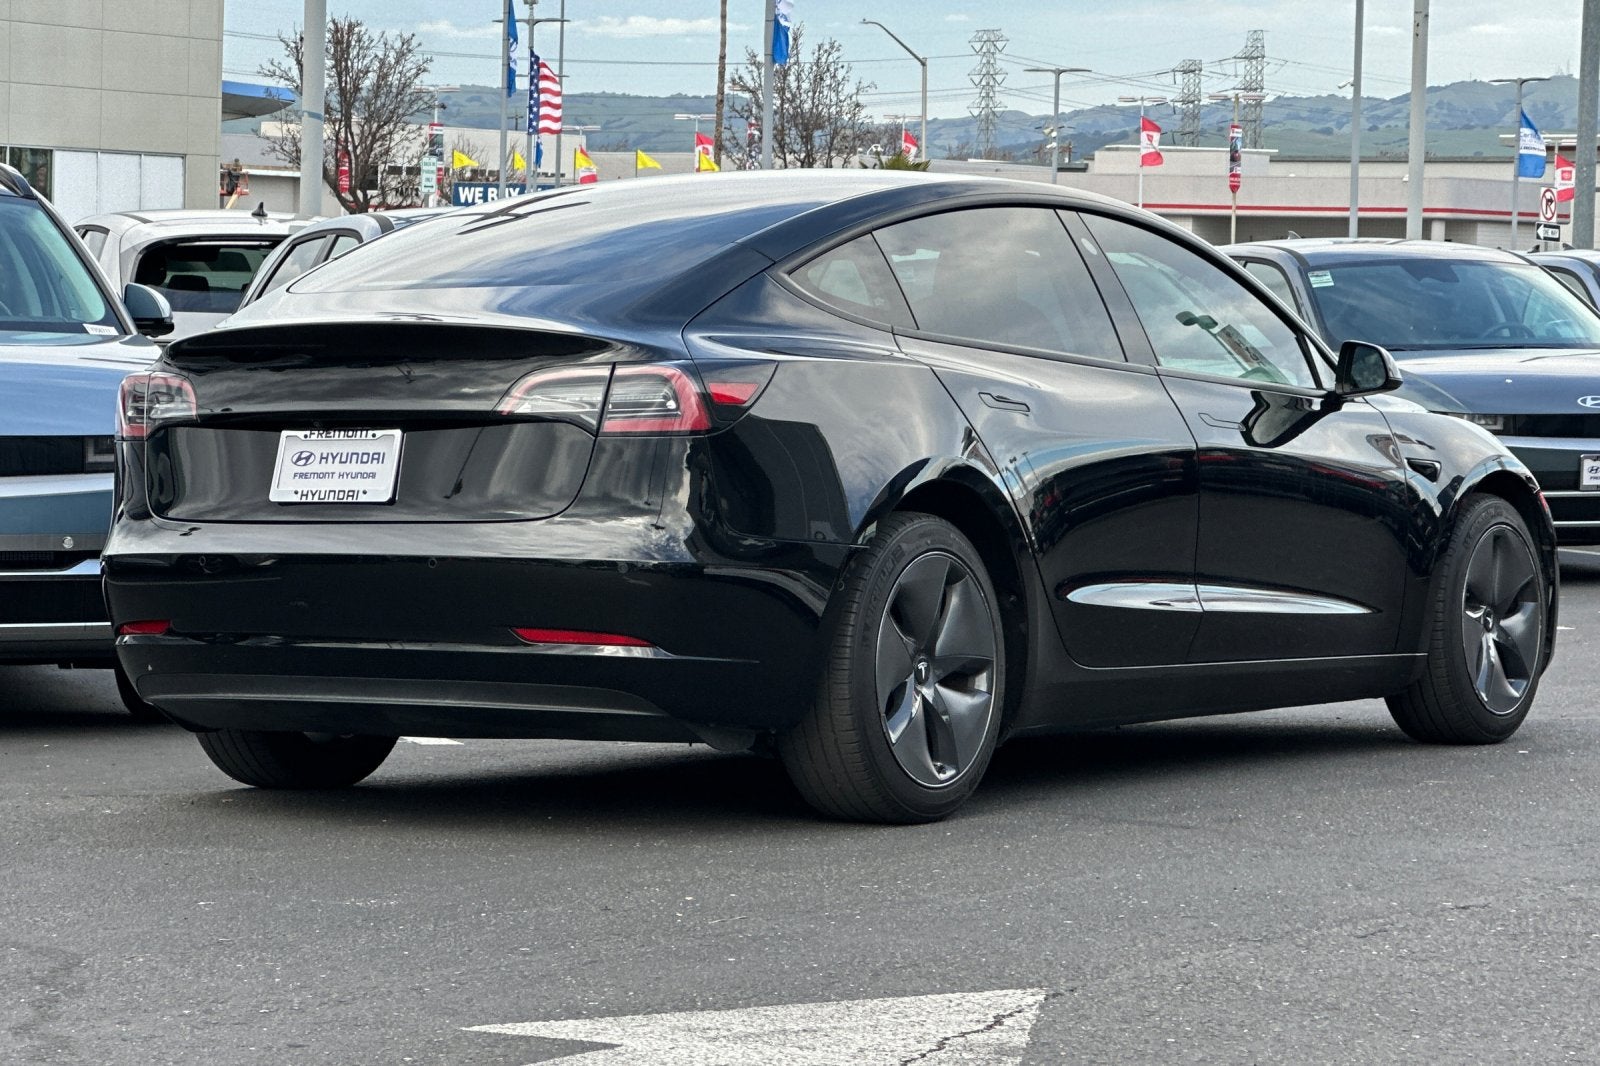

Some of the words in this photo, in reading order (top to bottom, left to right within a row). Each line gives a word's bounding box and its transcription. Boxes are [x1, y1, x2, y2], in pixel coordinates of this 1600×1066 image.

[458, 186, 484, 204] WE
[309, 430, 369, 439] FREMONT
[319, 452, 385, 465] HYUNDAI
[300, 490, 359, 501] HYUNDAI
